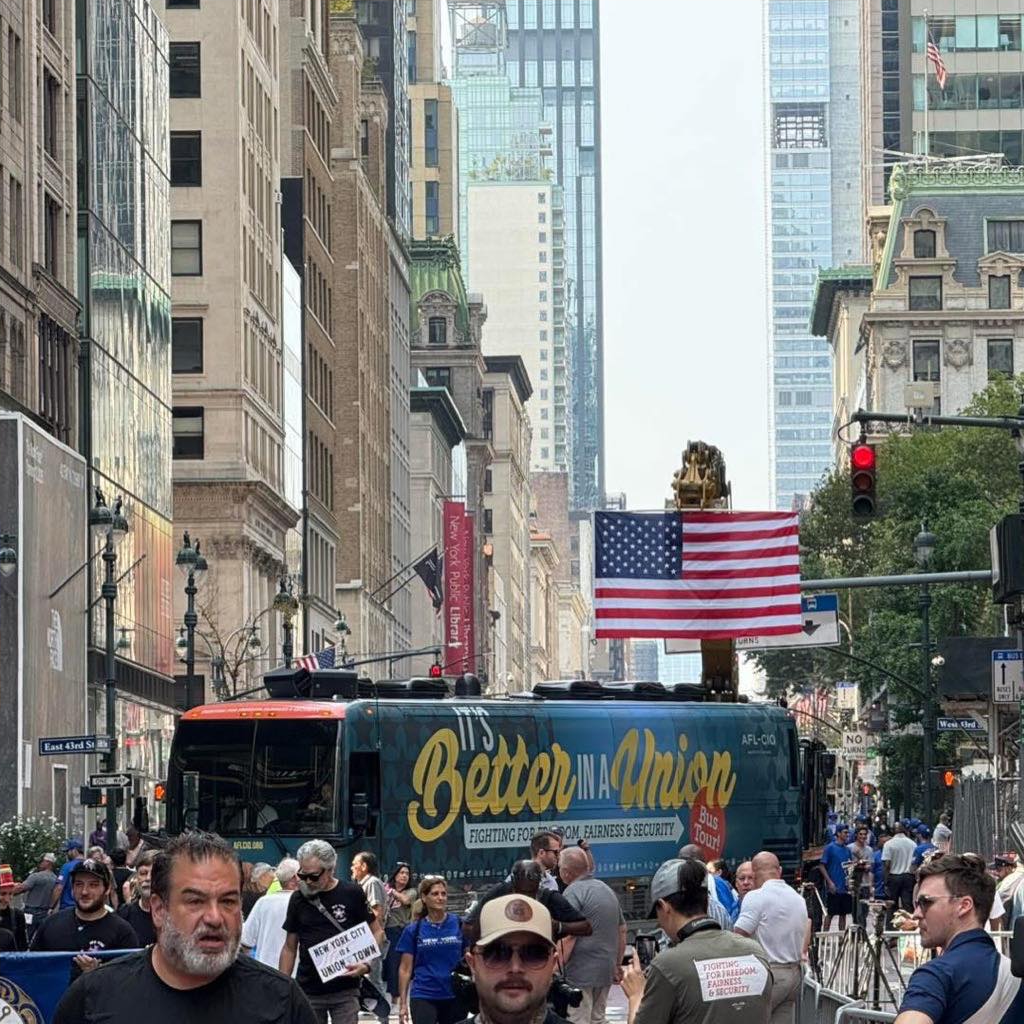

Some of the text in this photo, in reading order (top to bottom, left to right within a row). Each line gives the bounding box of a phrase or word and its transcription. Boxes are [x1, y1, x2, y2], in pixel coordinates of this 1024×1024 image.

[449, 516, 461, 540] New
[449, 543, 462, 566] York
[449, 571, 462, 601] Public
[453, 707, 494, 752] IT'S
[939, 720, 959, 728] West
[43, 742, 63, 751] East
[64, 741, 84, 751] 43rd
[741, 734, 777, 746] AFL-CIO
[843, 746, 865, 754] TURNS
[846, 734, 863, 745] NO
[407, 727, 737, 843] Better IN A Union
[698, 806, 719, 829] Bus
[469, 822, 675, 844] FIGHTING FOR FAIRNESS & SECURITY
[694, 830, 721, 851] Tour!
[313, 926, 367, 958] NEW YORK CITY
[320, 945, 377, 977] UNION TOWN
[703, 960, 740, 972] FIGHTING
[706, 970, 722, 980] FOR
[707, 977, 742, 988] FAIRNESS
[708, 990, 715, 998] &
